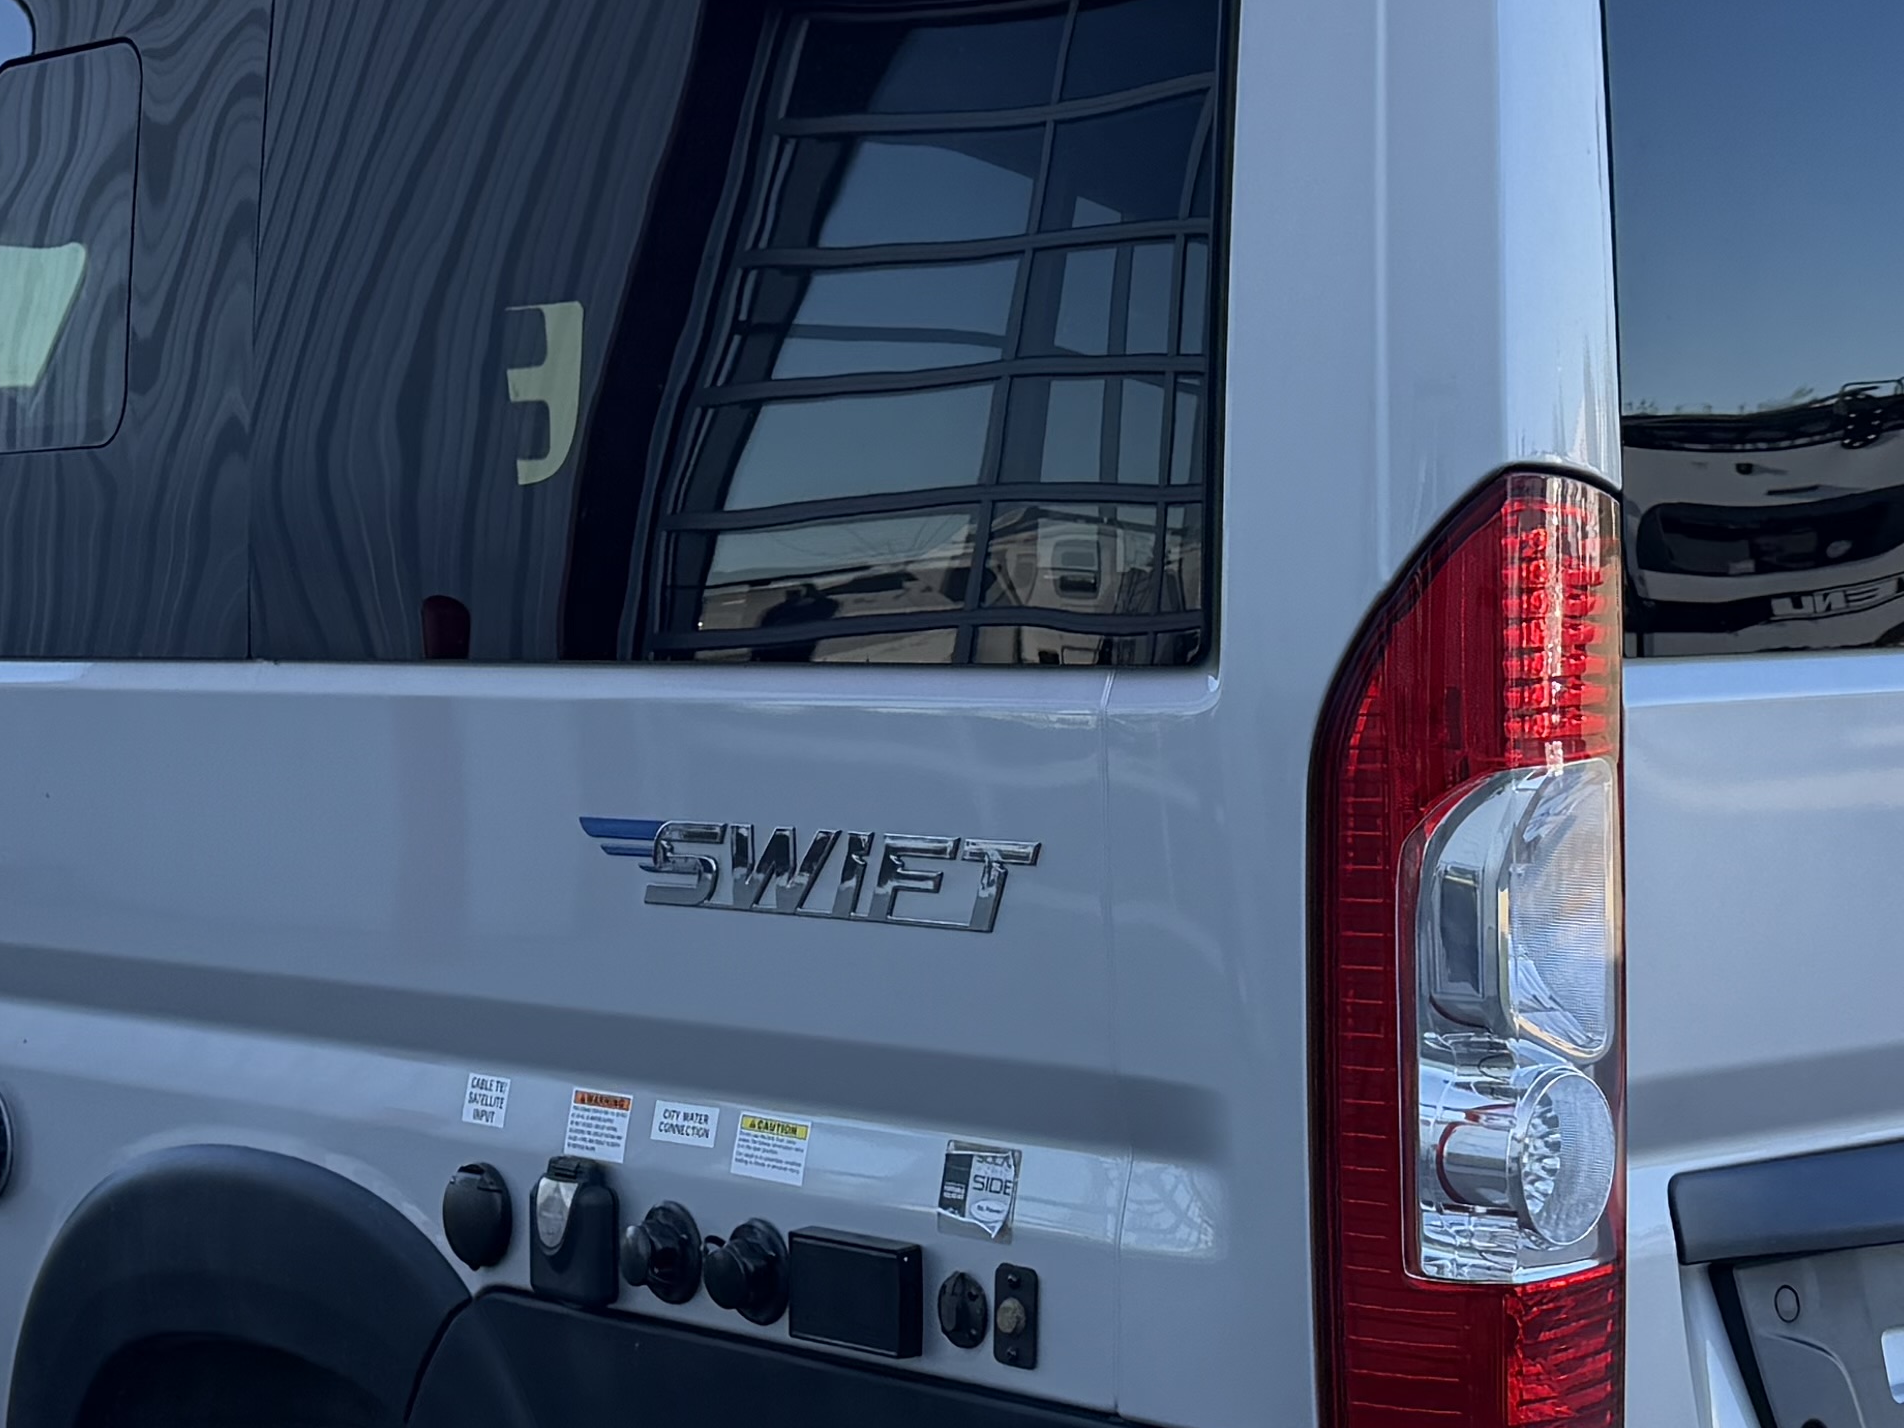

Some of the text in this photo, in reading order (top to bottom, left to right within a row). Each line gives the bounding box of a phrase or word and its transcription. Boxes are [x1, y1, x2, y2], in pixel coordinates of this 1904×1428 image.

[639, 820, 1042, 933] SWIFT
[471, 1076, 493, 1092] CABLE
[468, 1091, 505, 1110] SATELLITE
[473, 1108, 496, 1124] INPUT
[663, 1108, 709, 1124] CITY WATER
[658, 1122, 710, 1139] CONNECTION
[758, 1119, 798, 1136] CAUTION
[973, 1174, 1013, 1196] SIDE
